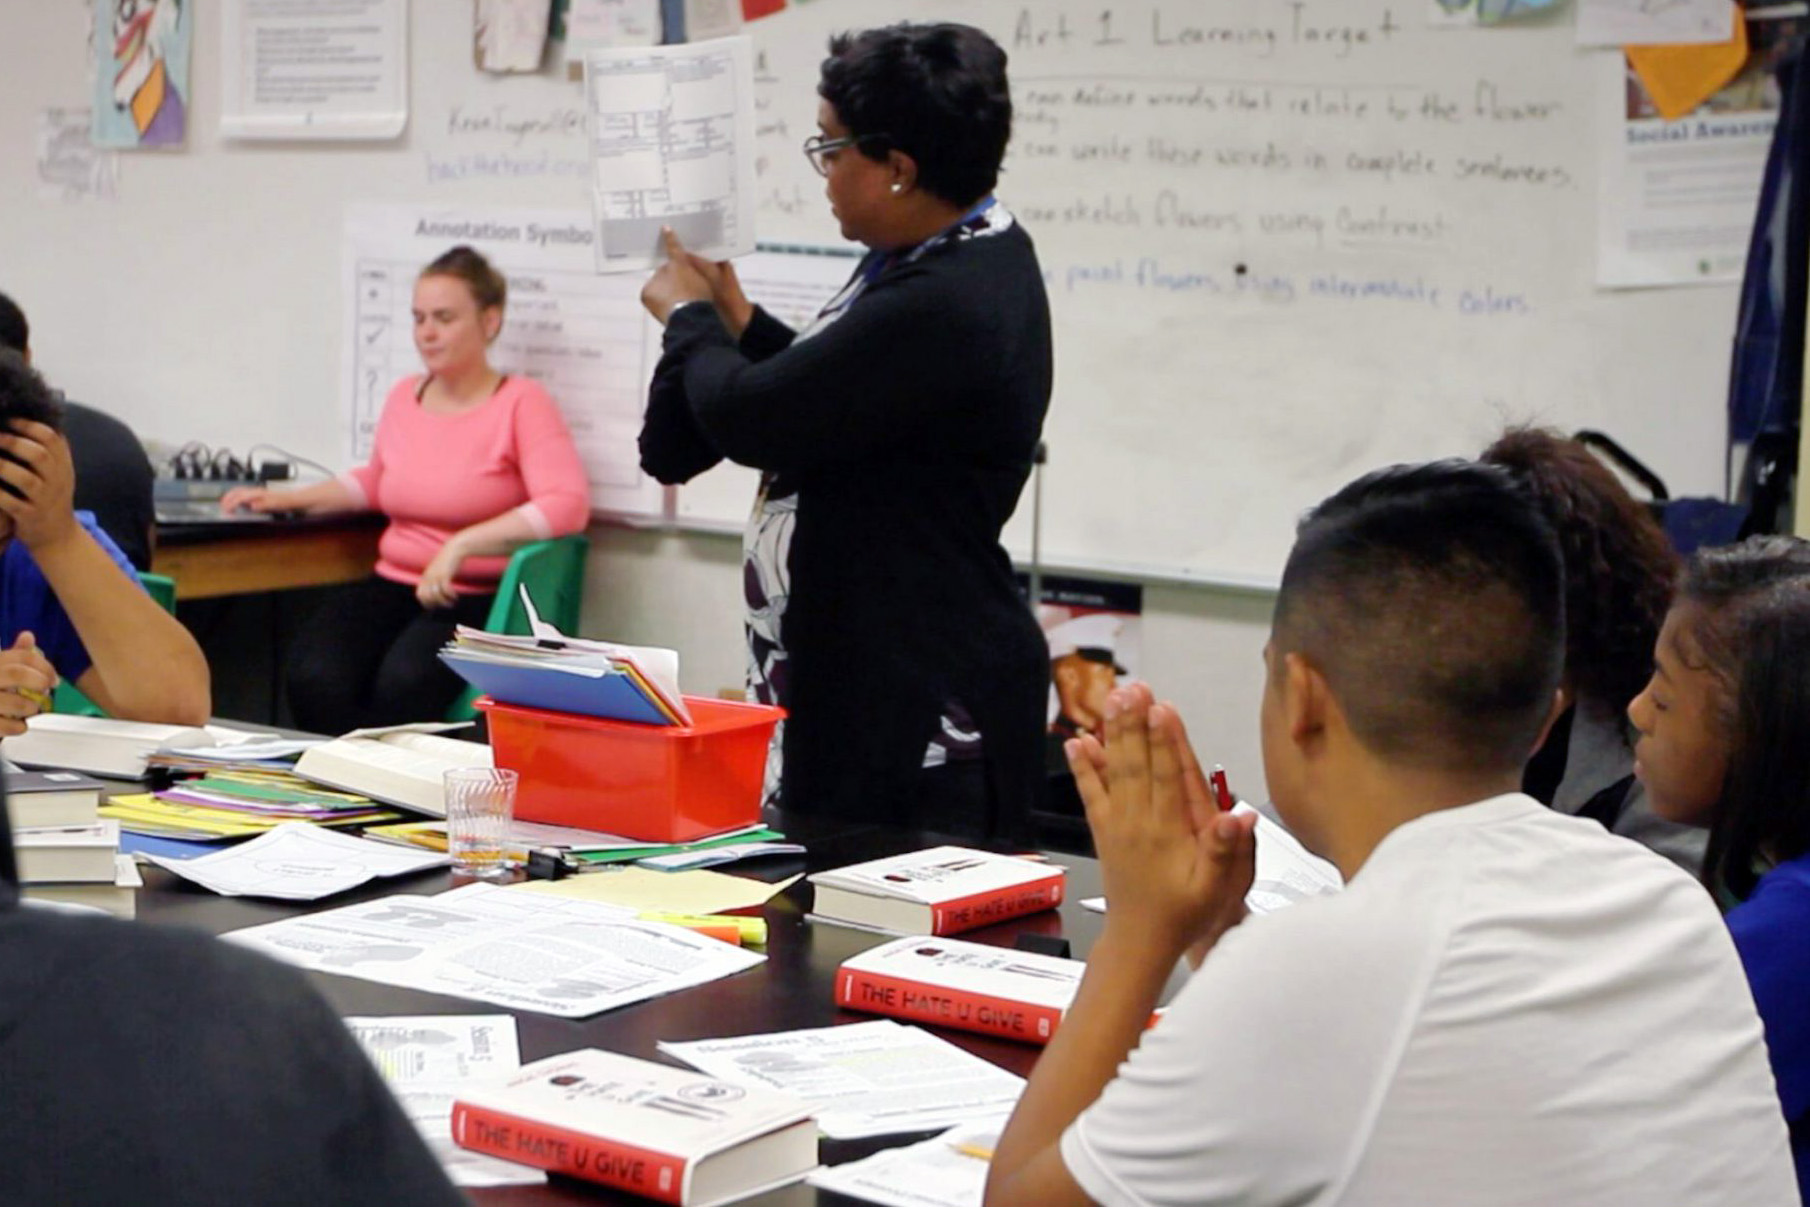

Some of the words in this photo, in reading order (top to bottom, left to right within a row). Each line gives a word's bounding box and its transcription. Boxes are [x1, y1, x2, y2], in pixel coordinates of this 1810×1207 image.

[1015, 9, 1072, 47] Art
[1094, 9, 1125, 46] 1
[1152, 9, 1275, 58] Learning
[1284, 2, 1401, 58] Target
[1147, 86, 1216, 110] words
[1225, 88, 1271, 110] that
[1290, 90, 1367, 117] relate
[1420, 92, 1458, 122] the
[1626, 123, 1688, 143] Social
[1215, 141, 1292, 169] words
[1062, 195, 1141, 228] sketch
[415, 218, 520, 241] Annotation
[527, 223, 594, 247] Symbo
[948, 907, 970, 924] THE
[974, 899, 1005, 919] HATE
[1018, 889, 1046, 910] GIVE
[861, 982, 896, 1007] THE
[902, 990, 953, 1018] HATE
[957, 1003, 970, 1021] U
[978, 1006, 1024, 1034] GIVE
[473, 1120, 510, 1150] THE
[516, 1128, 568, 1166] HATE
[574, 1148, 588, 1170] U
[594, 1151, 645, 1186] GIVE
